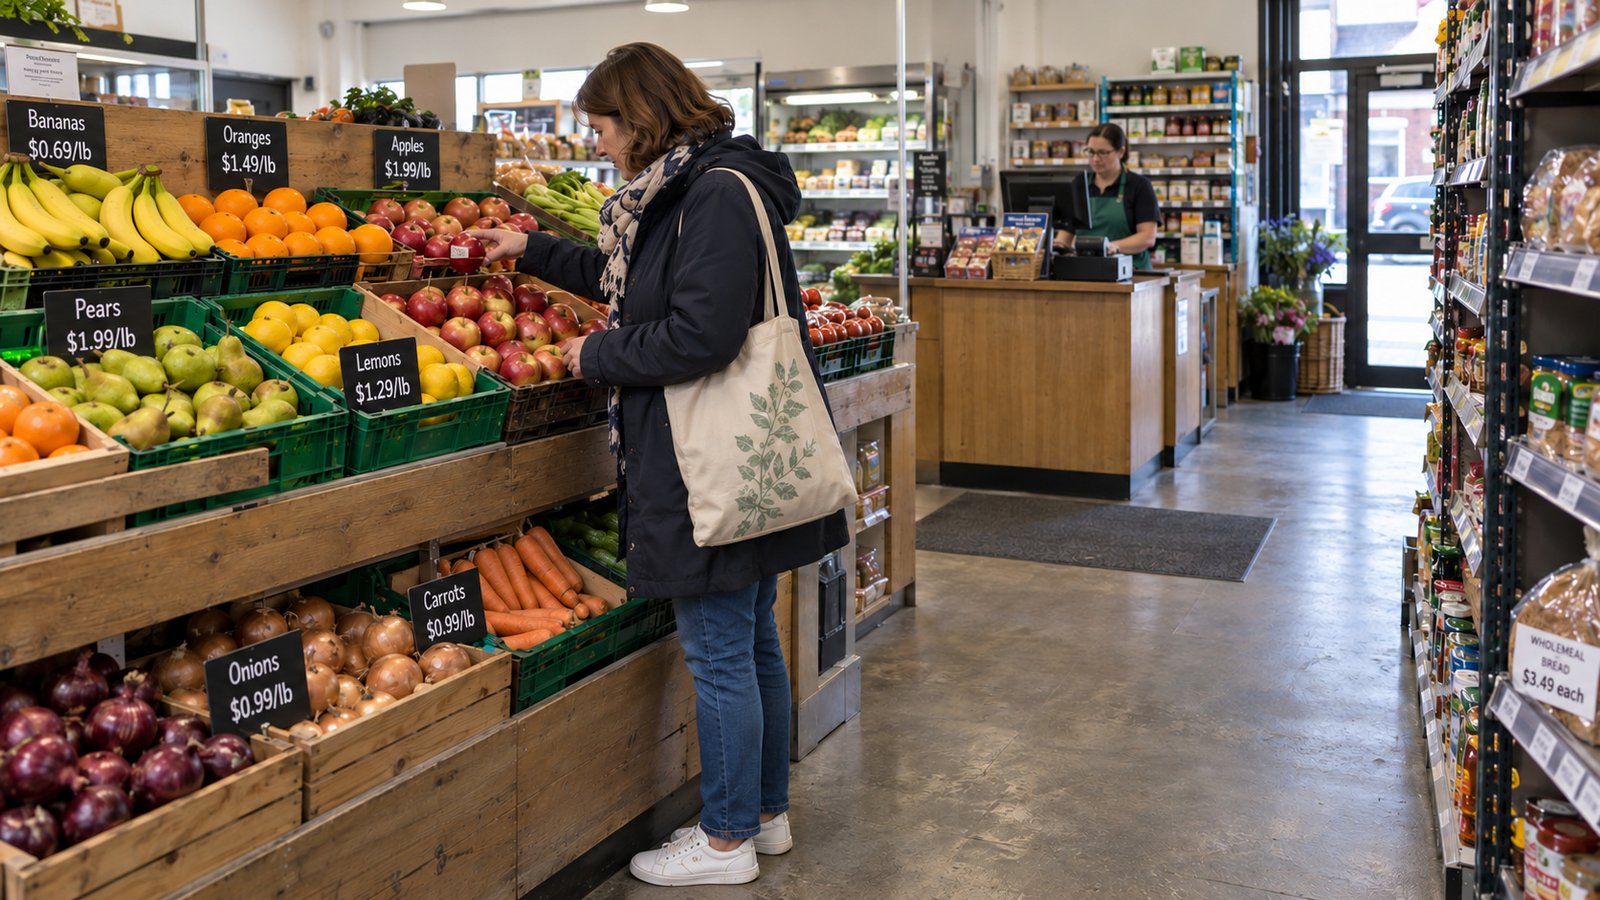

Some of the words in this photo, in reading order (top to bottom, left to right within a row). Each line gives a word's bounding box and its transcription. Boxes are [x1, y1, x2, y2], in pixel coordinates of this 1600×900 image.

[28, 108, 86, 132] Bananas
[28, 137, 92, 162] $0.69/lb
[223, 125, 272, 149] Oranges
[391, 135, 425, 156] Apples
[221, 152, 276, 175] $1.49/lb
[384, 159, 432, 179] $1.99/lb
[75, 297, 121, 320] Pears
[66, 326, 137, 355] $1.99/lb
[356, 352, 402, 372] Lemons
[355, 376, 411, 406] $1.29/lb
[423, 584, 466, 611] Carrots
[427, 610, 475, 641] $0.99/lb
[1530, 634, 1585, 662] WHOLEMEAL
[228, 655, 280, 685] Onions
[1541, 656, 1570, 675] BREAD
[1522, 668, 1555, 693] $3.49
[1556, 684, 1585, 704] each
[230, 682, 293, 724] $0.99/lb
